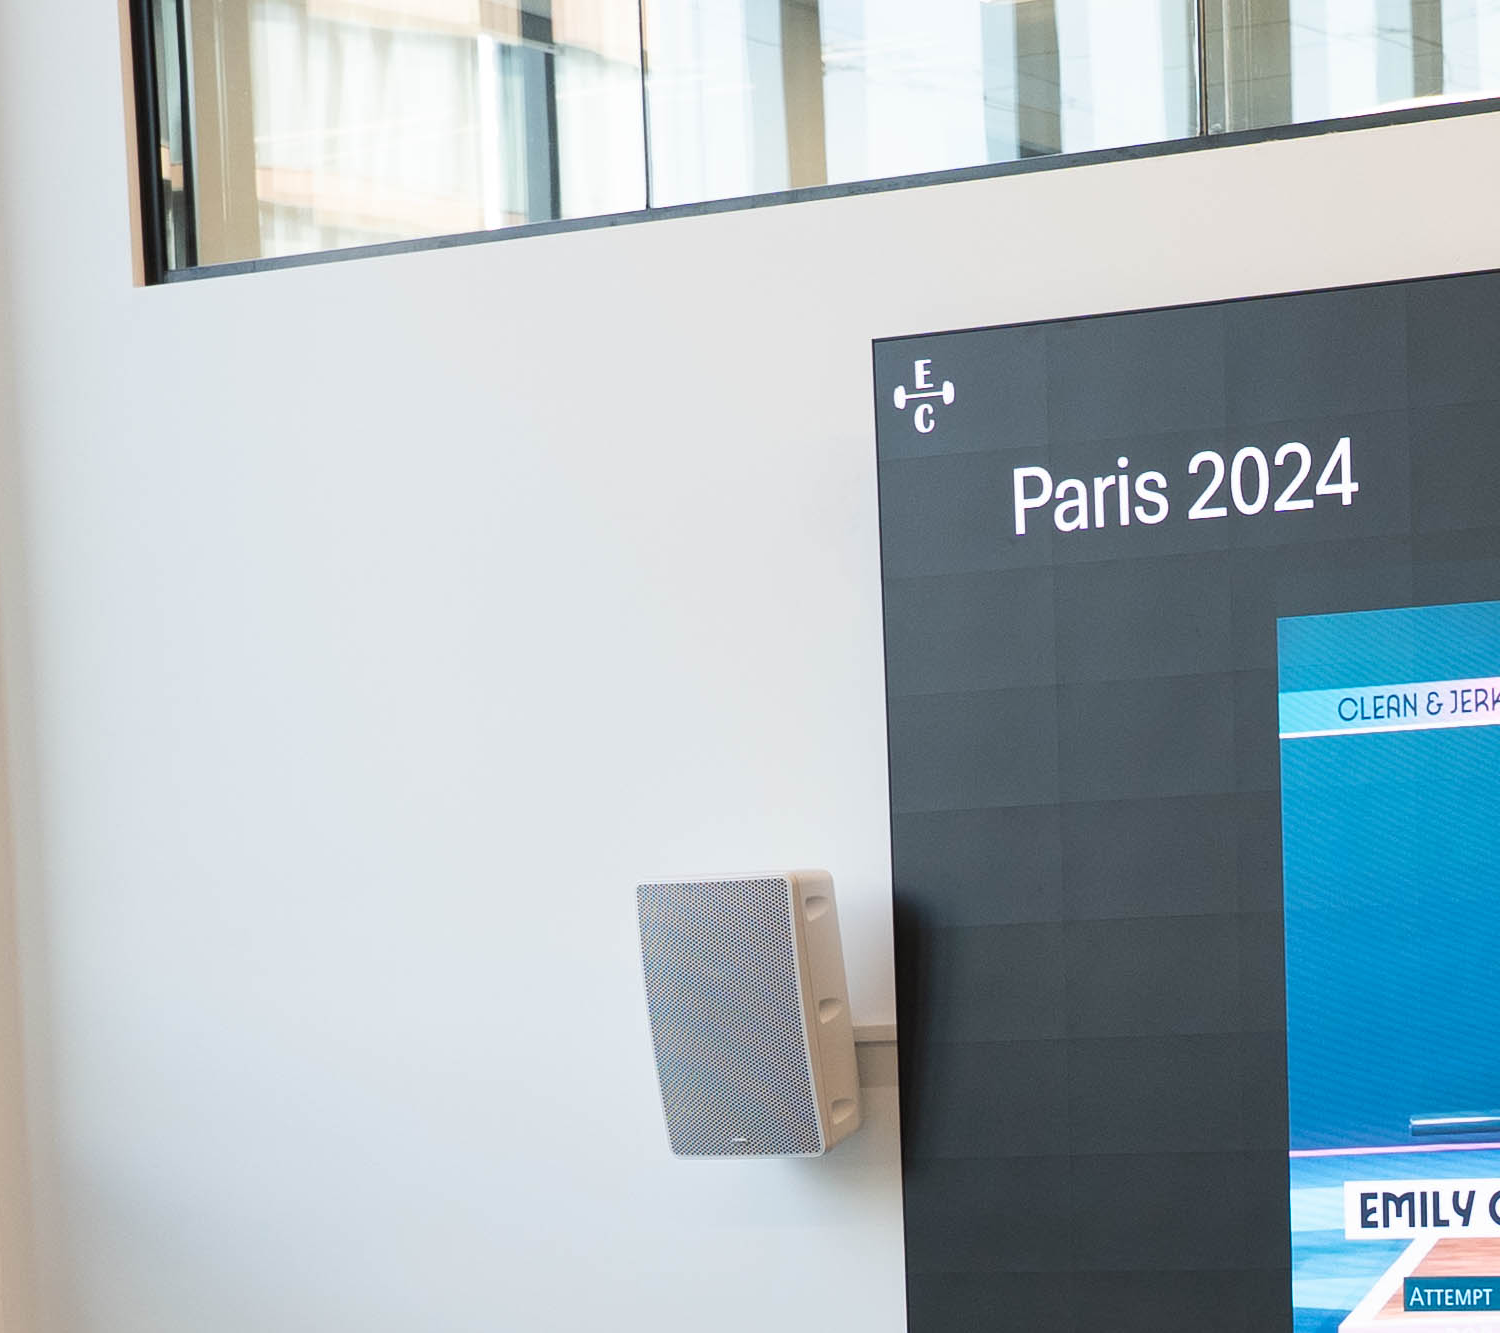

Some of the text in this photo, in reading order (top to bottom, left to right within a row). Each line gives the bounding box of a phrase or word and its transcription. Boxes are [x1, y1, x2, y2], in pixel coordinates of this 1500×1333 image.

[914, 359, 934, 390] E
[913, 403, 936, 433] C
[1012, 436, 1359, 536] Paris 2024
[1337, 692, 1418, 722] CLEAN
[1426, 691, 1444, 716] &
[1359, 1189, 1476, 1229] EMILY
[1409, 1286, 1493, 1307] ATTEMPT
